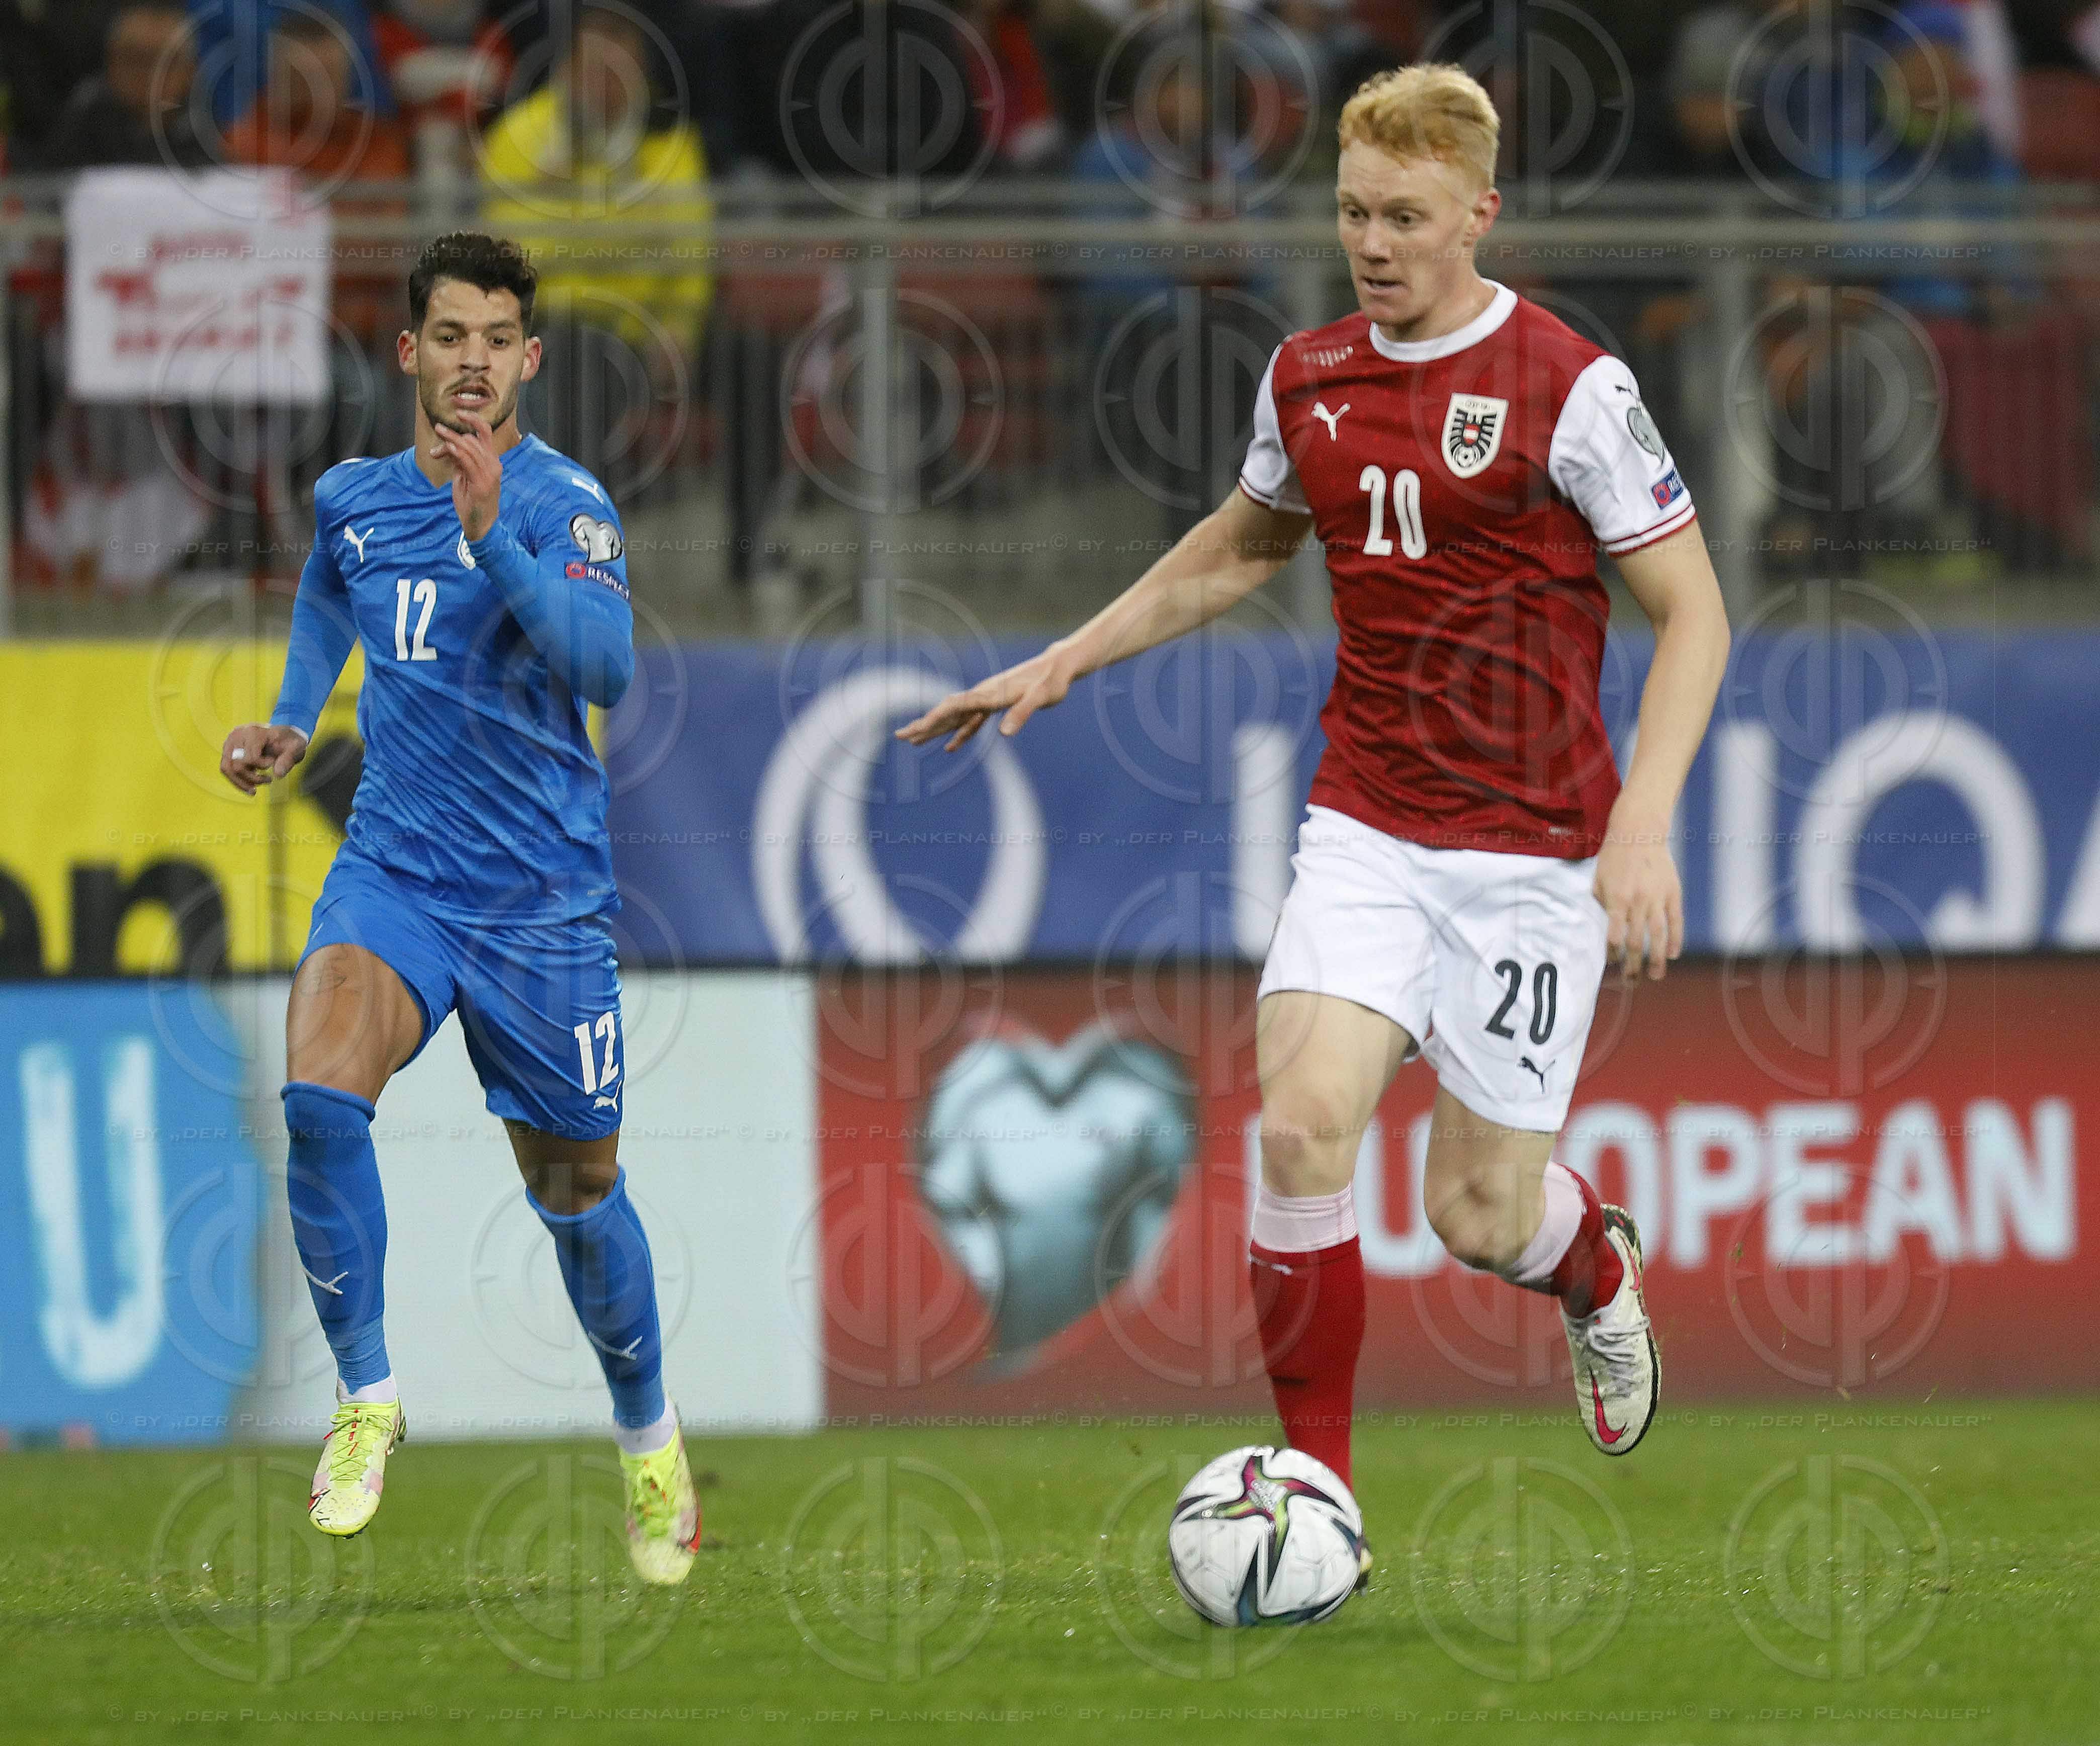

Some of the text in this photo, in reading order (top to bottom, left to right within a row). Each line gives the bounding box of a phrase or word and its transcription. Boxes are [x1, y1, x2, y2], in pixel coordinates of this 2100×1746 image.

[1359, 465, 1427, 560] 20
[394, 578, 439, 661] 12
[1484, 959, 1557, 1045] 20
[574, 1011, 619, 1095] 12
